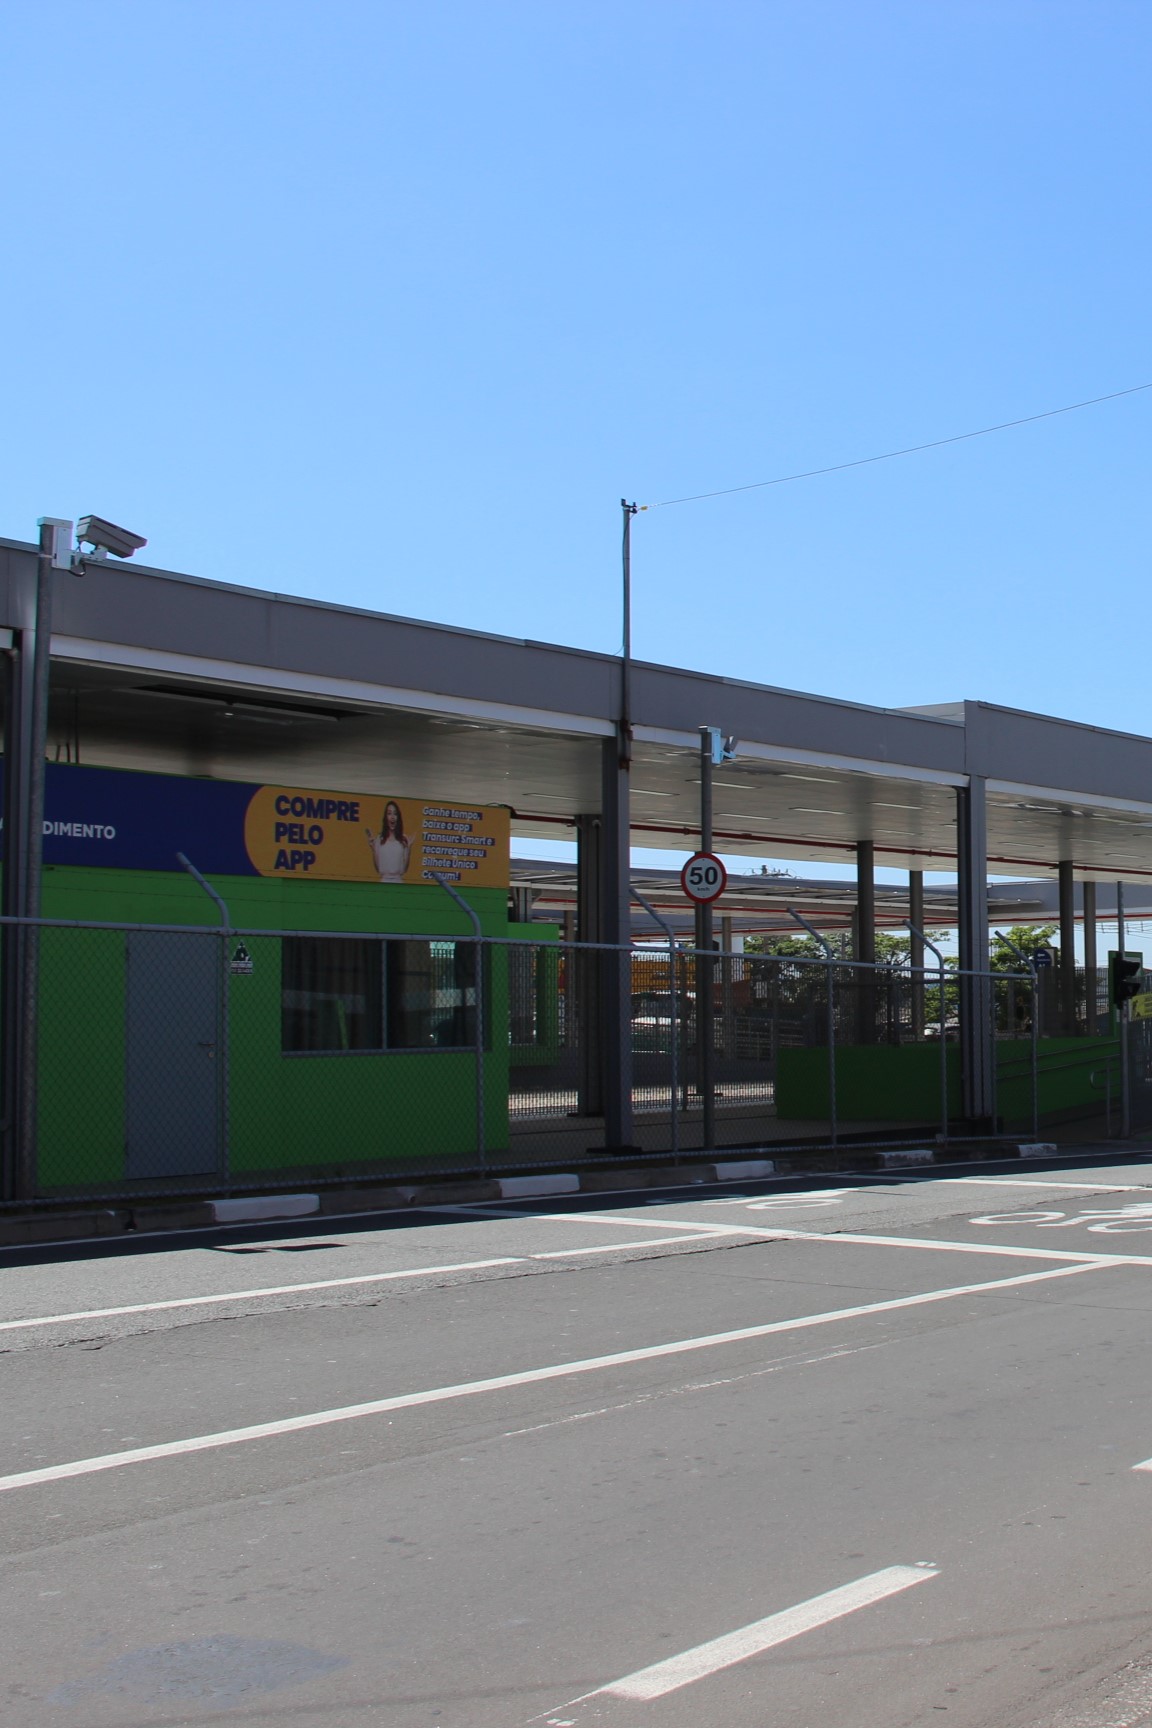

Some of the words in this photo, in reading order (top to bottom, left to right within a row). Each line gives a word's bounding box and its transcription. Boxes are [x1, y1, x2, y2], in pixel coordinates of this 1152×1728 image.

[274, 795, 360, 823] COMPRE
[423, 807, 450, 816] Ganhe
[43, 821, 116, 840] DIMENTO
[423, 820, 446, 829] baixe
[454, 825, 470, 833] app
[274, 821, 324, 846] PELO
[461, 835, 486, 844] Smart
[422, 846, 468, 858] recarregue
[469, 849, 484, 857] seu
[273, 848, 316, 872] APP
[422, 857, 452, 867] Bilhete
[423, 871, 459, 880] Coum!
[689, 866, 718, 885] 50
